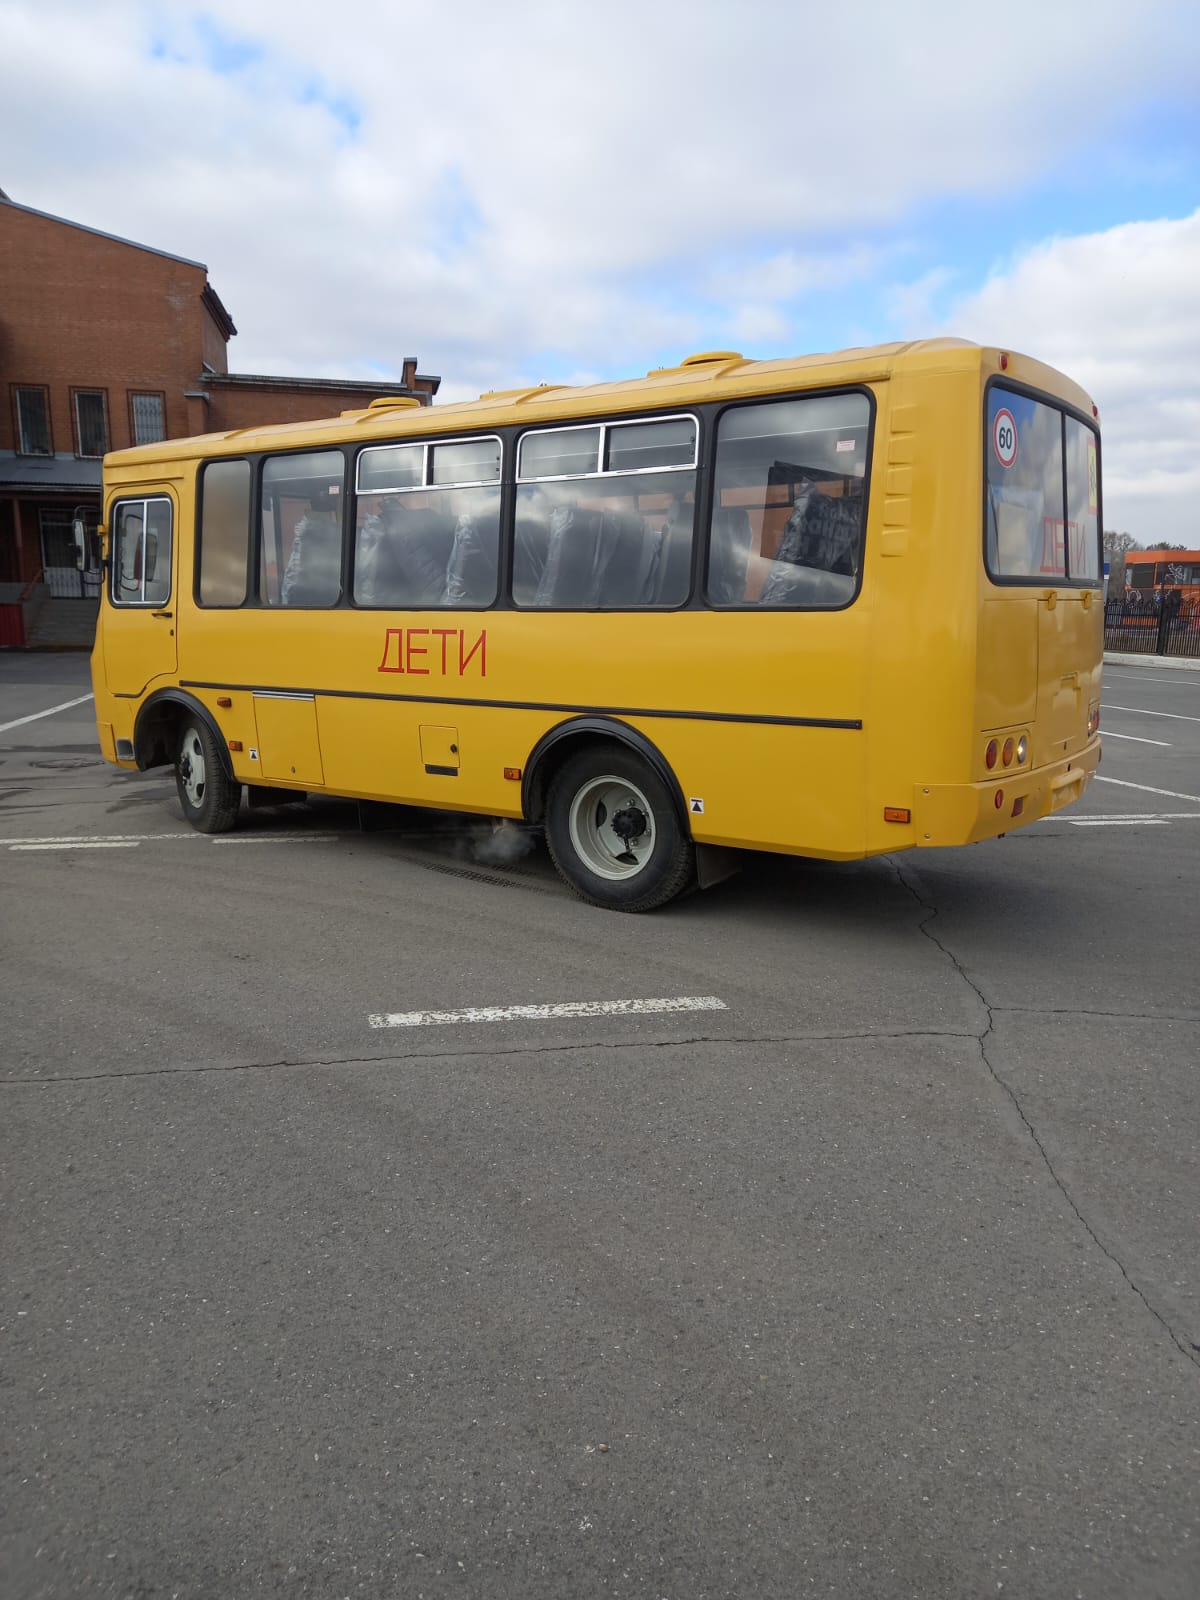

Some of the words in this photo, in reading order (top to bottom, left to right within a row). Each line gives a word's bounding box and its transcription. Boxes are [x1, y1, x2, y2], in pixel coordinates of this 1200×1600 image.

[999, 427, 1012, 450] 60
[1040, 517, 1086, 575] ДЕТИ
[378, 628, 487, 677] ДЕТИ
